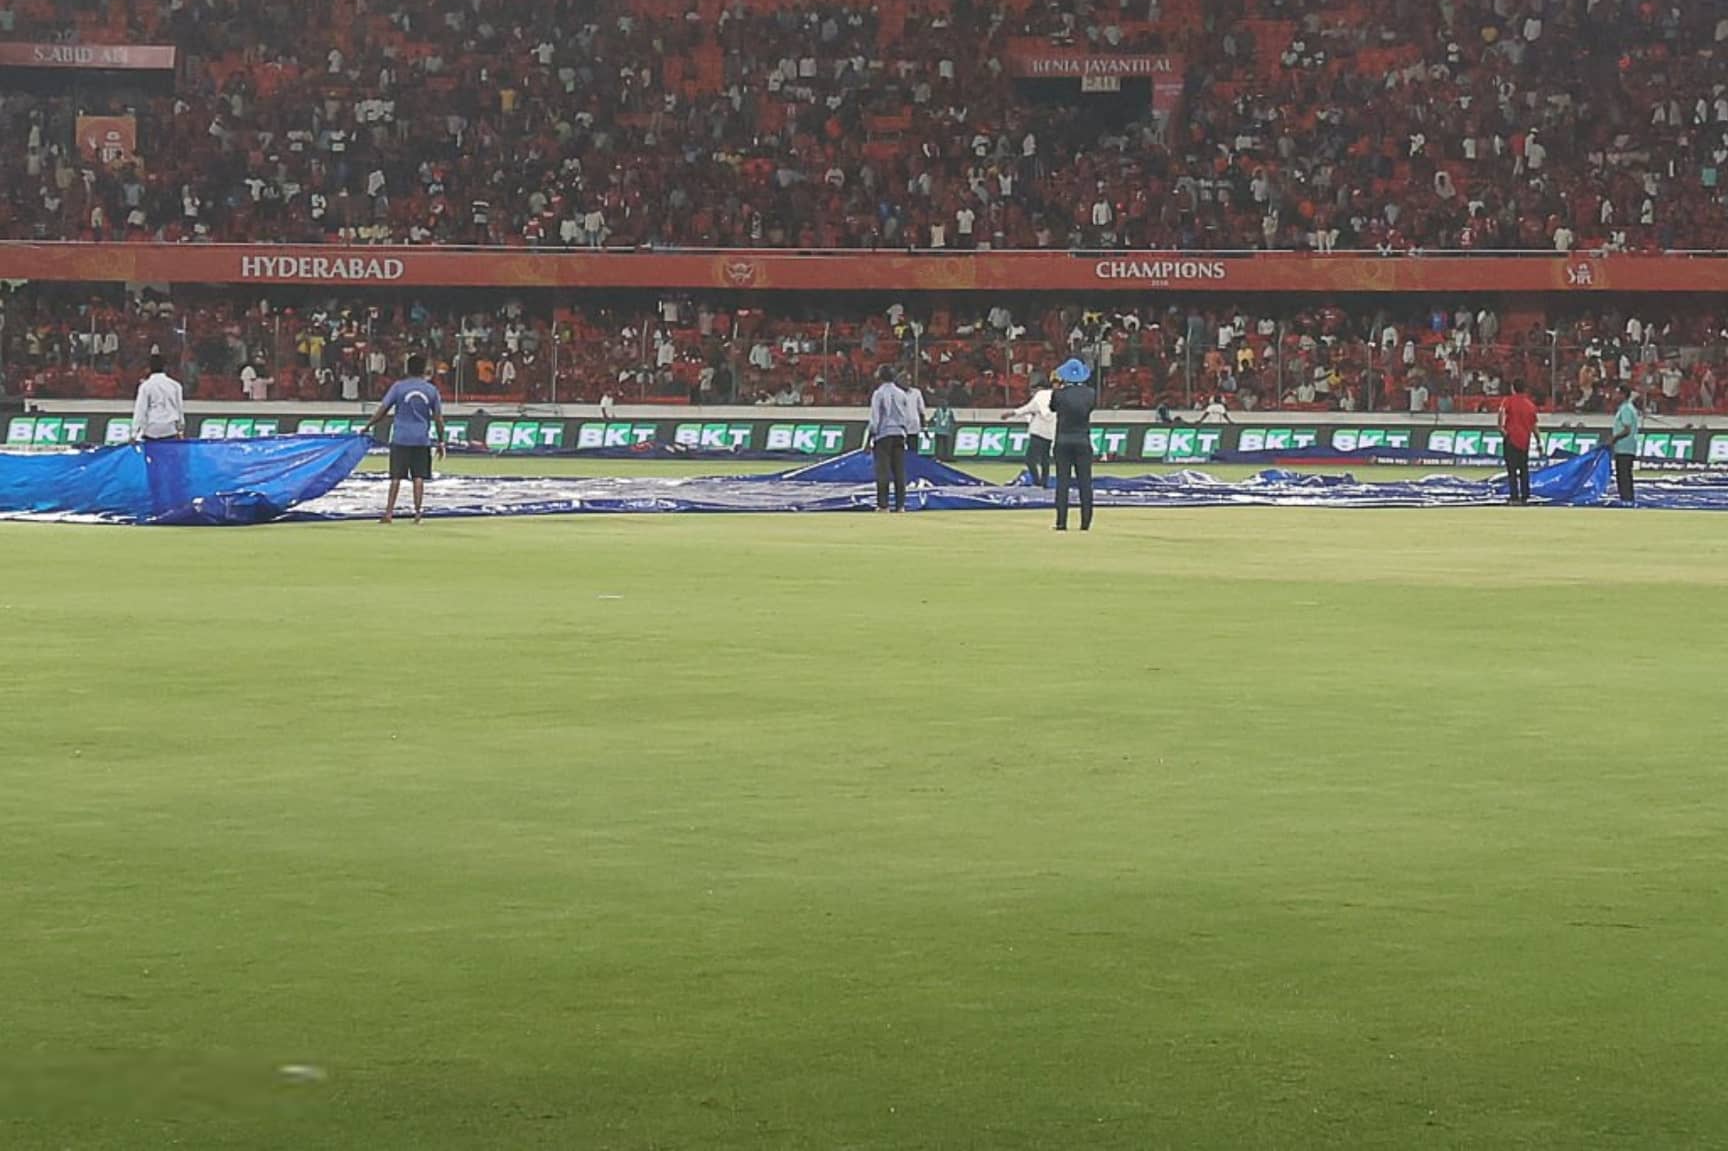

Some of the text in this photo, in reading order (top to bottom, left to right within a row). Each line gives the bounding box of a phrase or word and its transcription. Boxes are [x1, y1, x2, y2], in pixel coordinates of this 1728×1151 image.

[241, 255, 404, 280] HYDERABAD
[1095, 261, 1226, 279] CHAMPIONS
[7, 423, 86, 442] BKT
[486, 425, 564, 446] BKT
[579, 428, 655, 447] BKT
[767, 430, 844, 450] BKT
[954, 432, 1030, 452] BKT
[1143, 434, 1219, 454] BKT
[1239, 434, 1316, 452] BKT
[1428, 435, 1504, 456] BKT
